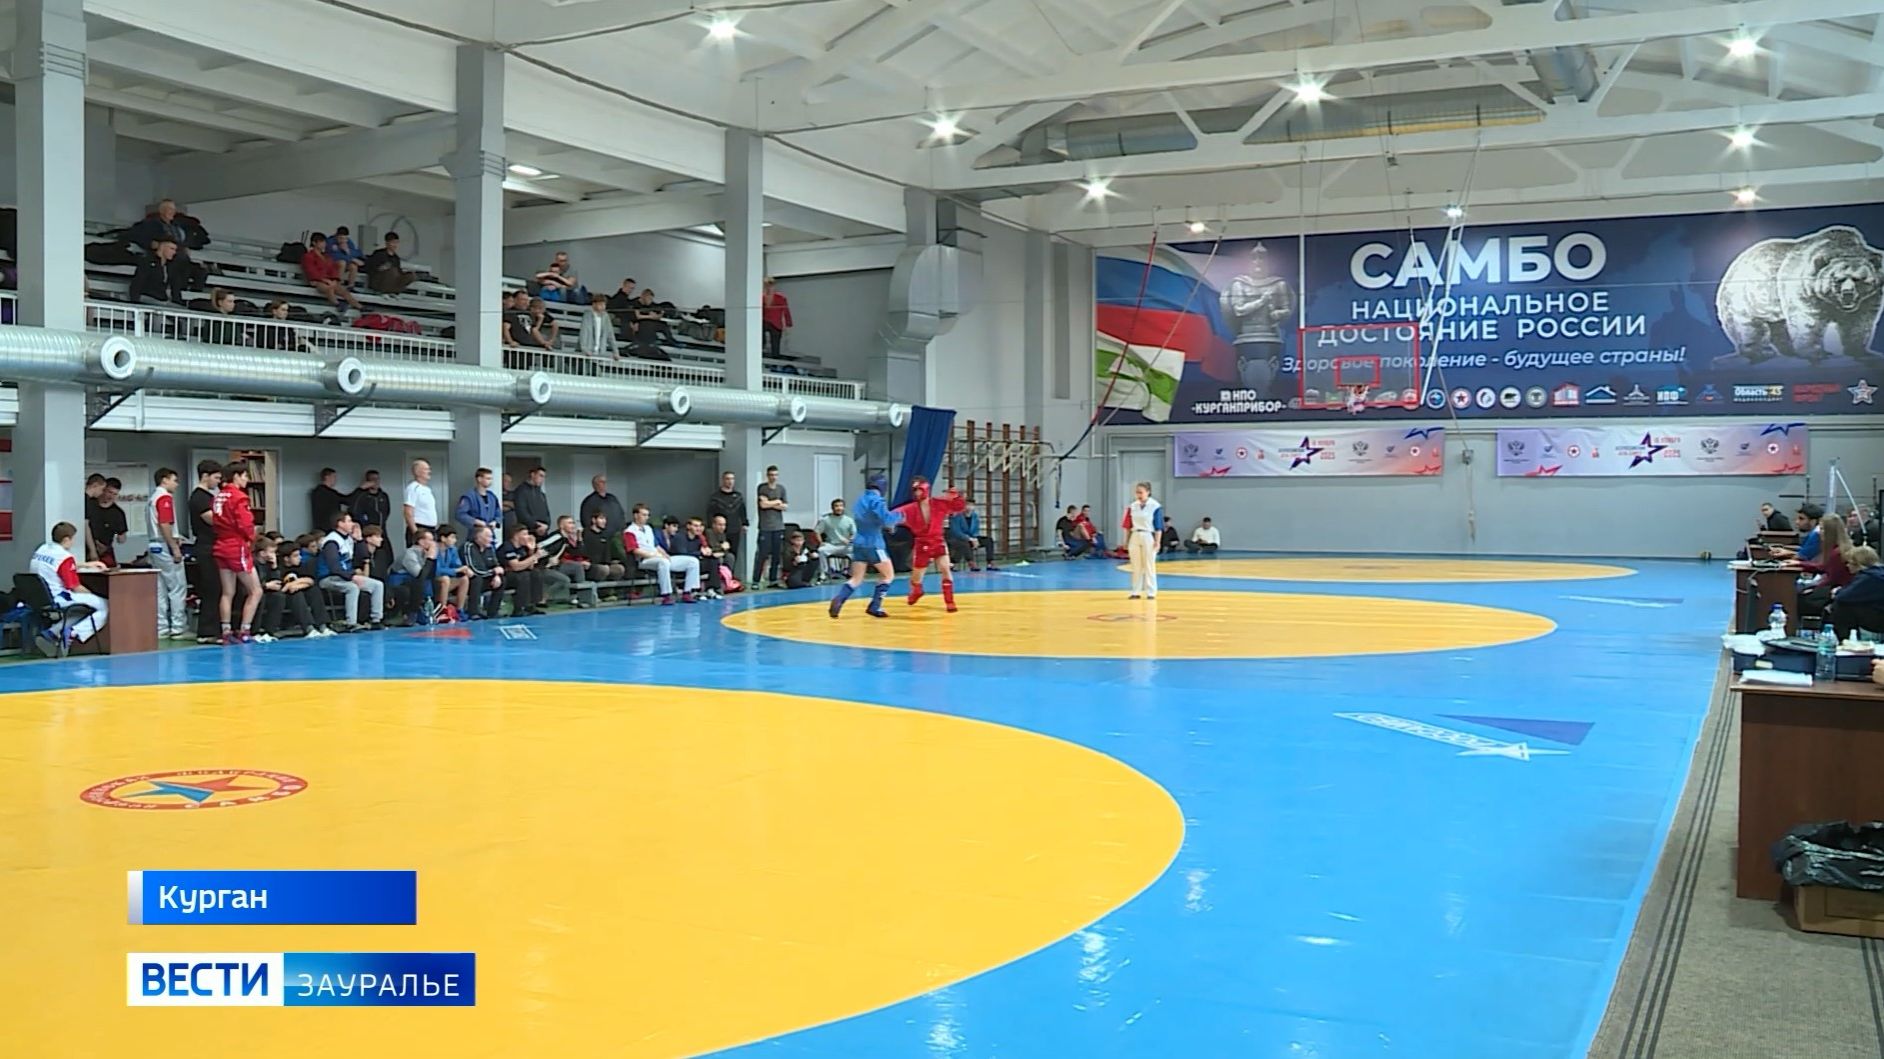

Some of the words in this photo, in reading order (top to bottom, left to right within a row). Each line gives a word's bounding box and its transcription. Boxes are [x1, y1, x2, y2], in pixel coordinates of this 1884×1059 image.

[1351, 232, 1606, 289] САМБО
[1352, 291, 1609, 321] НАЦИОНАЛЬНОЕ
[1318, 319, 1499, 346] ДОСТОЯНИЕ
[1517, 315, 1647, 338] РОССИИ
[1504, 350, 1595, 369] будущее
[1599, 347, 1686, 366] страны!
[1232, 389, 1257, 401] НПО
